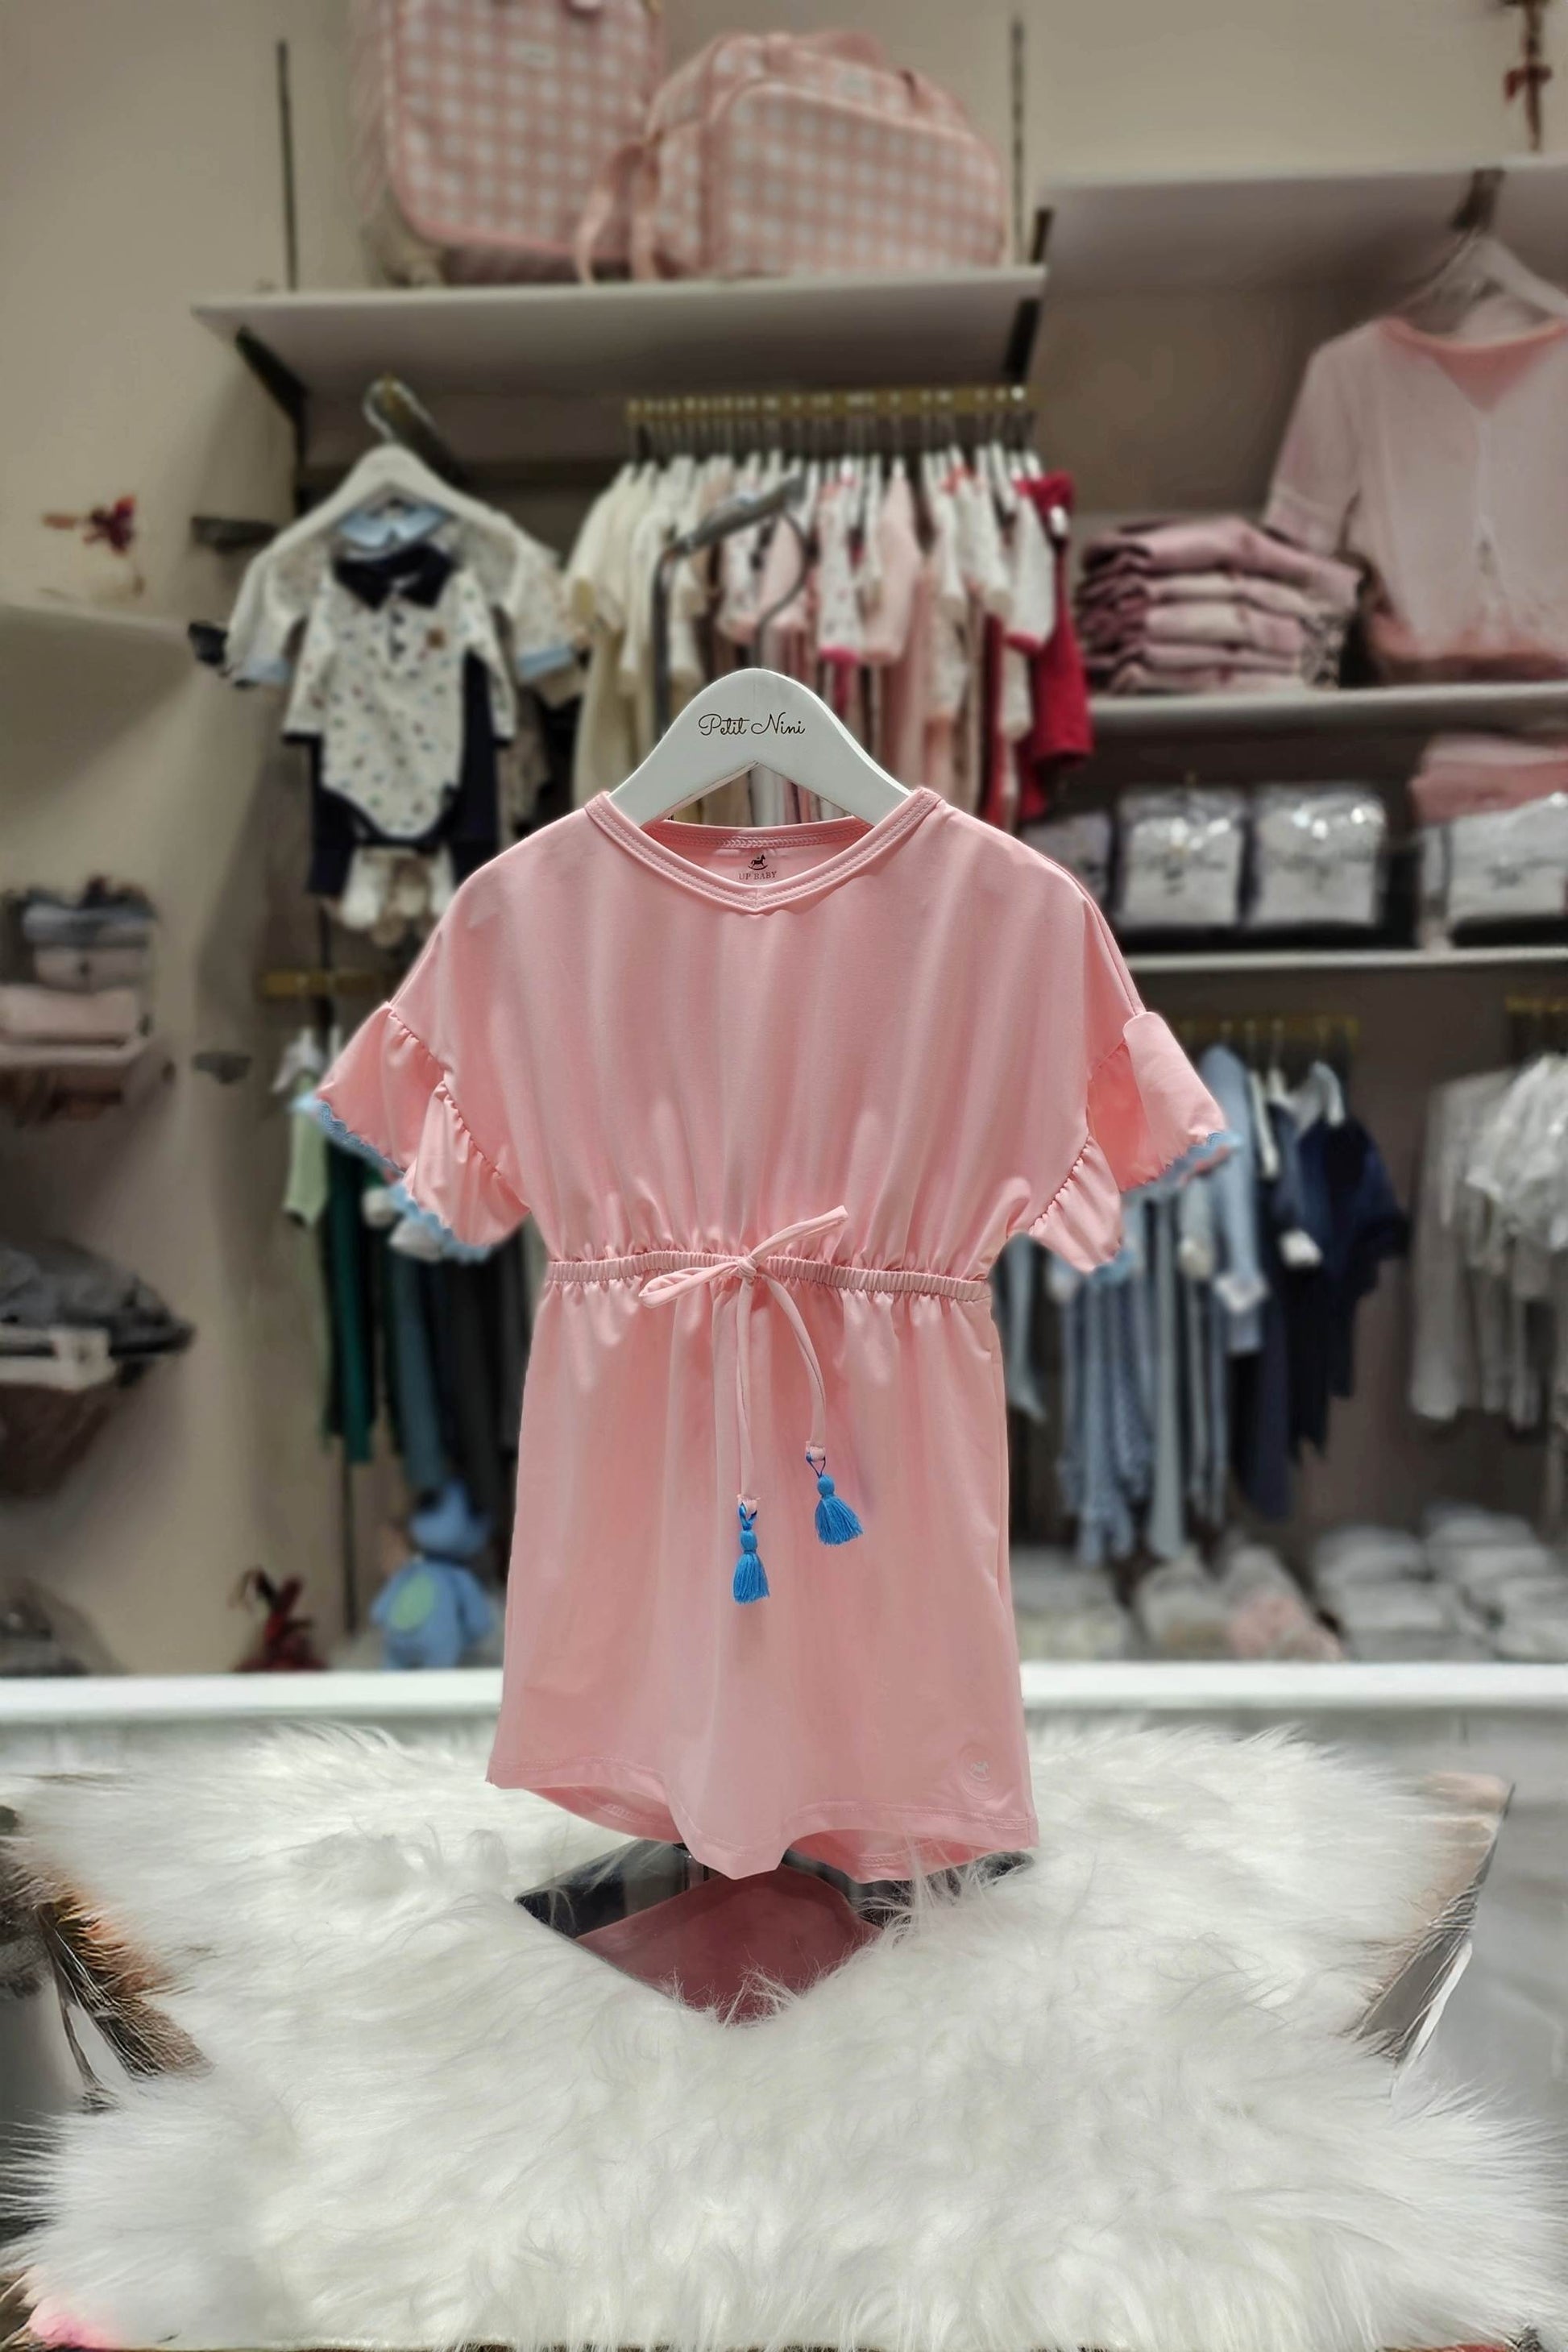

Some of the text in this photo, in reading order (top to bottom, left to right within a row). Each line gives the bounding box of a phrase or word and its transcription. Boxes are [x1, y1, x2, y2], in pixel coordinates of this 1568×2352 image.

[698, 711, 806, 736] Petit Nini
[754, 871, 777, 880] BABY
